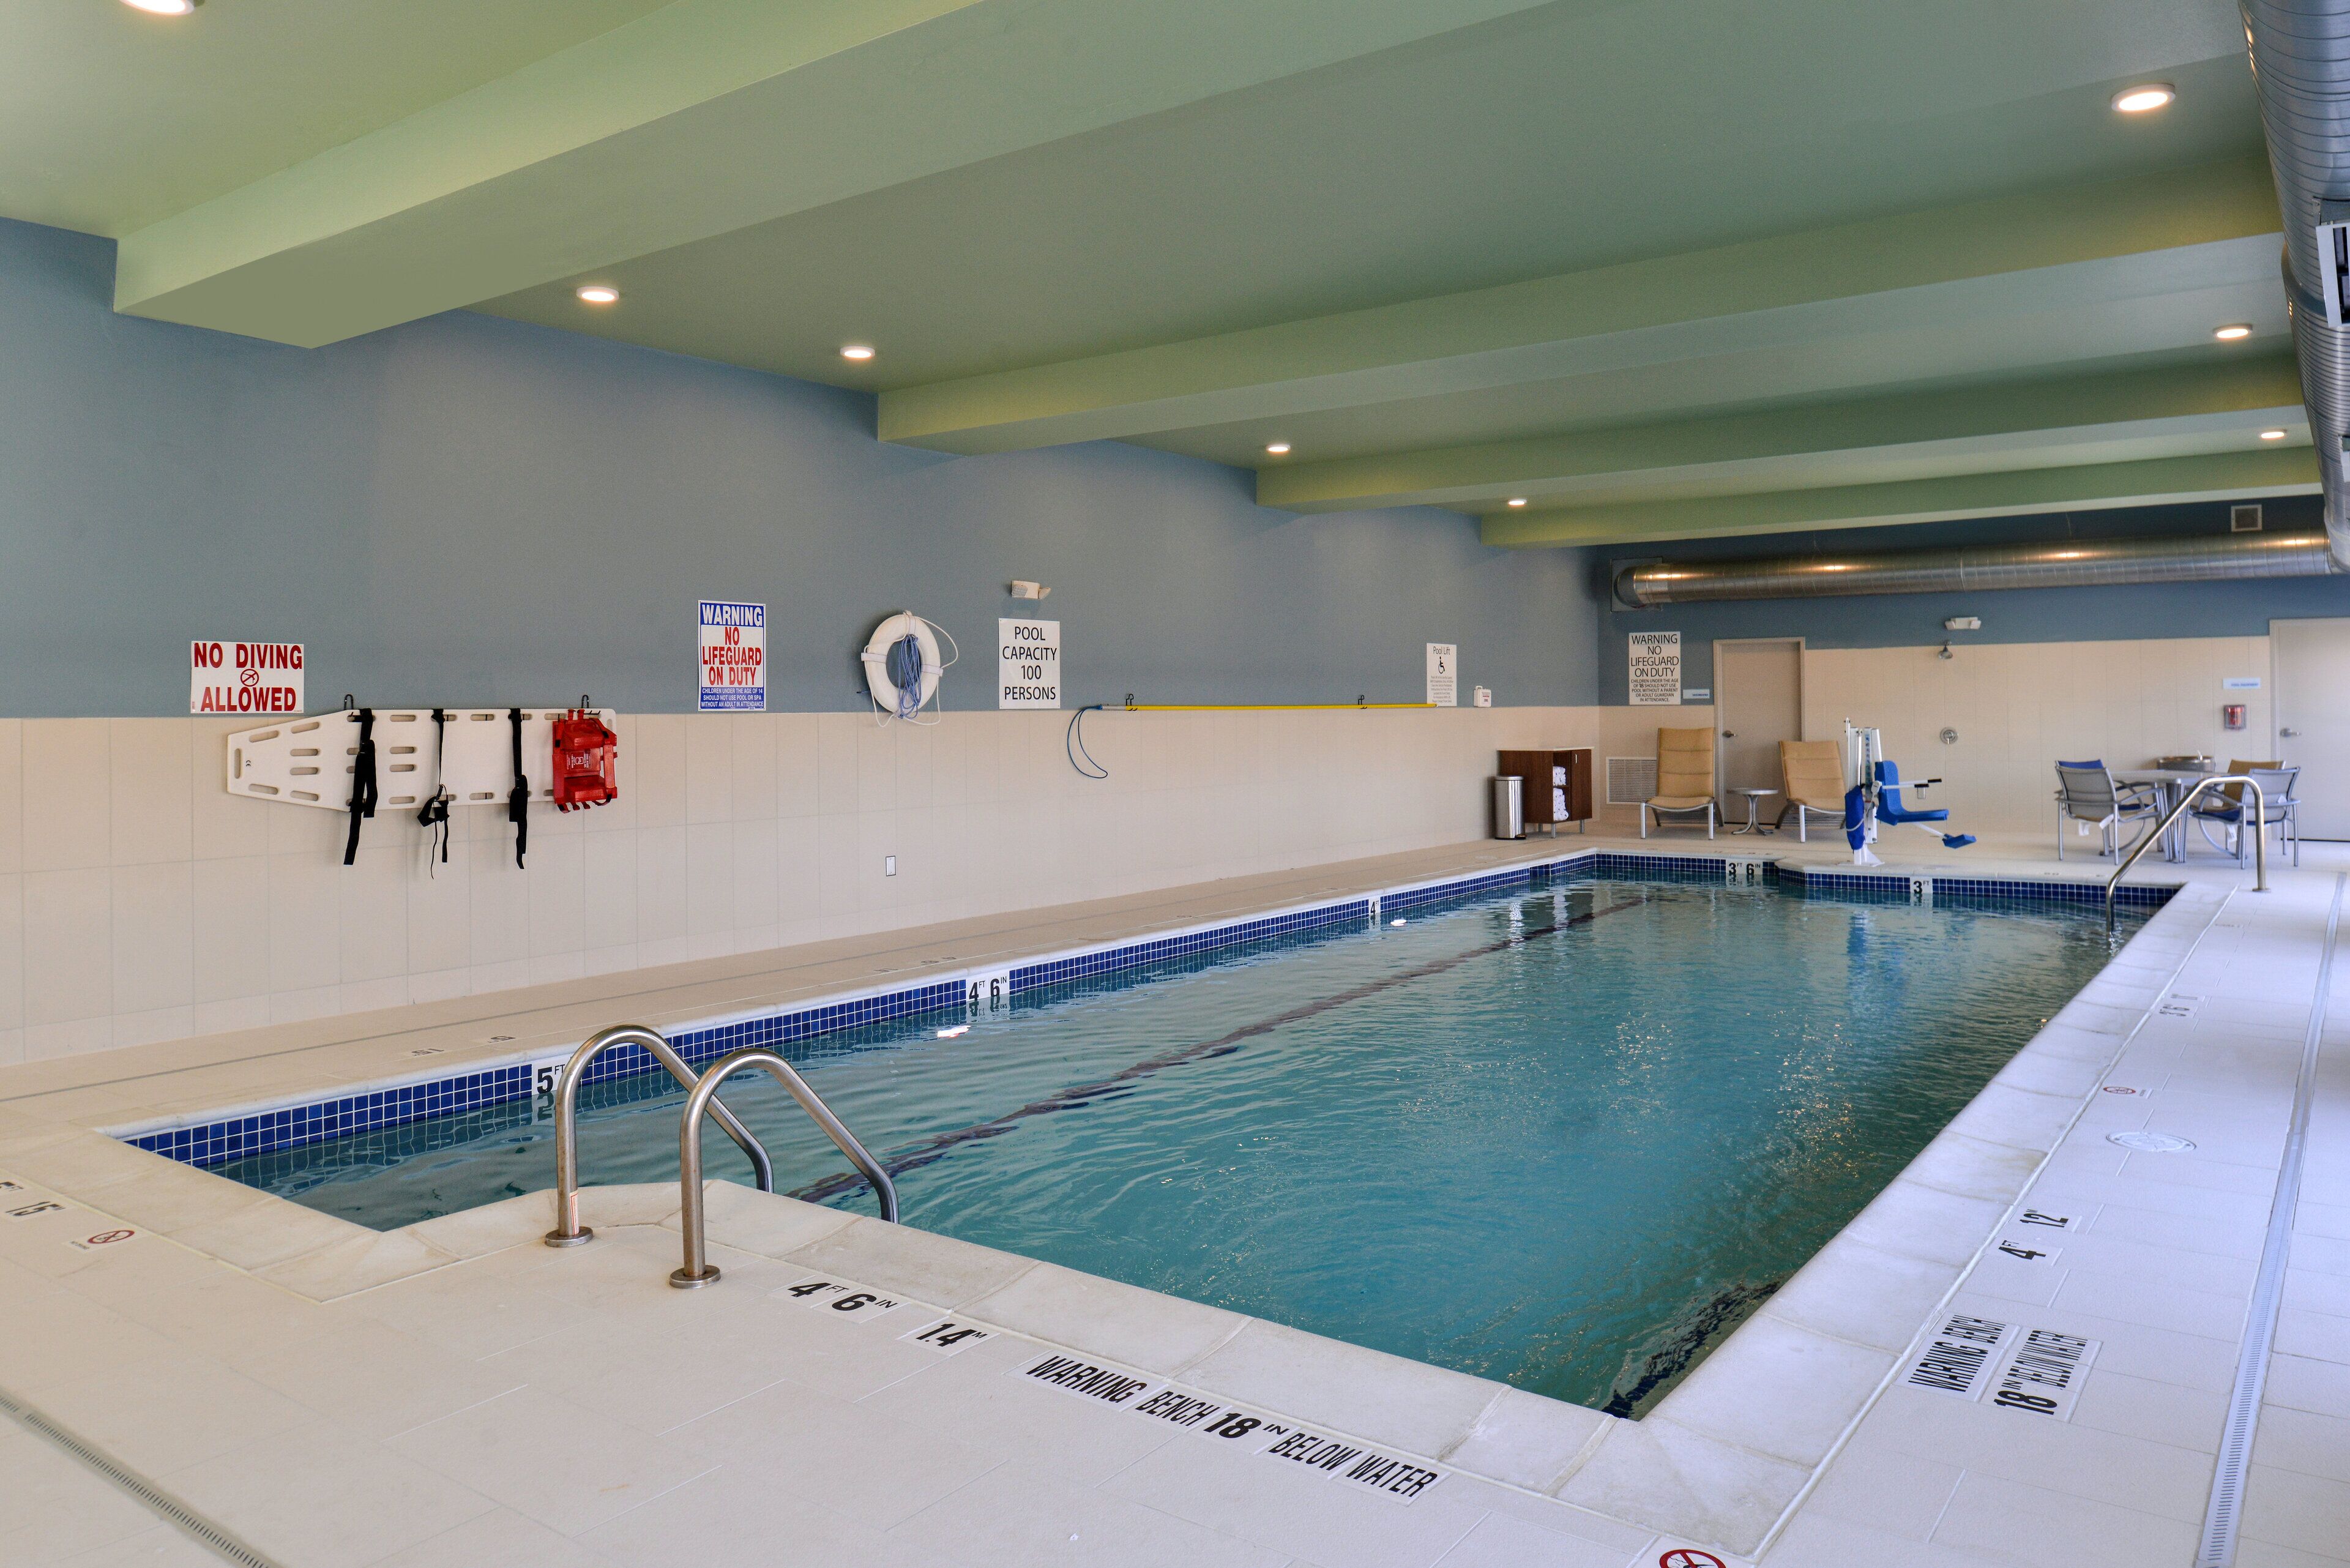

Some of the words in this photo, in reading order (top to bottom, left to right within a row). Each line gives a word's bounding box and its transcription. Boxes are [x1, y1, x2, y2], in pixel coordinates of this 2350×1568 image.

[702, 605, 763, 627] WARNING
[725, 627, 739, 645] NO
[1015, 626, 1045, 641] POOL
[1632, 634, 1677, 644] WARNING
[195, 643, 223, 668] NO
[236, 644, 302, 670] DIVING
[703, 646, 761, 666] LIFEGUARD
[1002, 646, 1057, 660] CAPACITY
[1433, 646, 1442, 655] Pool
[1647, 646, 1662, 655] NO
[1631, 656, 1679, 666] LIFEGUARD
[709, 666, 723, 685] ON
[729, 667, 756, 685] DUTY
[1021, 665, 1042, 680] 100
[1635, 668, 1649, 677] ON
[1651, 668, 1675, 677] DUTY
[201, 687, 296, 712] ALLOWED
[1004, 686, 1056, 700] PERSONS
[1729, 863, 1736, 874] 3
[1747, 864, 1754, 875] 6
[1914, 881, 1922, 894] 3
[1371, 902, 1376, 914] 4
[969, 982, 979, 1001] 4
[990, 979, 1000, 996] 6
[1001, 976, 1007, 984] IN
[537, 1067, 553, 1094] 5
[554, 1064, 565, 1075] FT
[1998, 1247, 2046, 1260] 4
[788, 1283, 832, 1297] 4
[832, 1293, 877, 1311] 6
[875, 1299, 899, 1309] IN
[916, 1323, 977, 1347] 1.4
[1941, 1314, 2007, 1345] BENCH
[2022, 1330, 2088, 1361] WATER
[1908, 1342, 1988, 1392] WARNING
[2007, 1352, 2075, 1388] BELOW
[1026, 1356, 1147, 1403] WARNING
[2001, 1379, 2023, 1390] IN
[1135, 1391, 1221, 1426] BENCH
[1994, 1390, 2057, 1415] 18
[1203, 1413, 1262, 1438] 18
[1263, 1424, 1289, 1435] IN
[1268, 1433, 1363, 1471] BELOW
[1346, 1455, 1438, 1498] WATER
